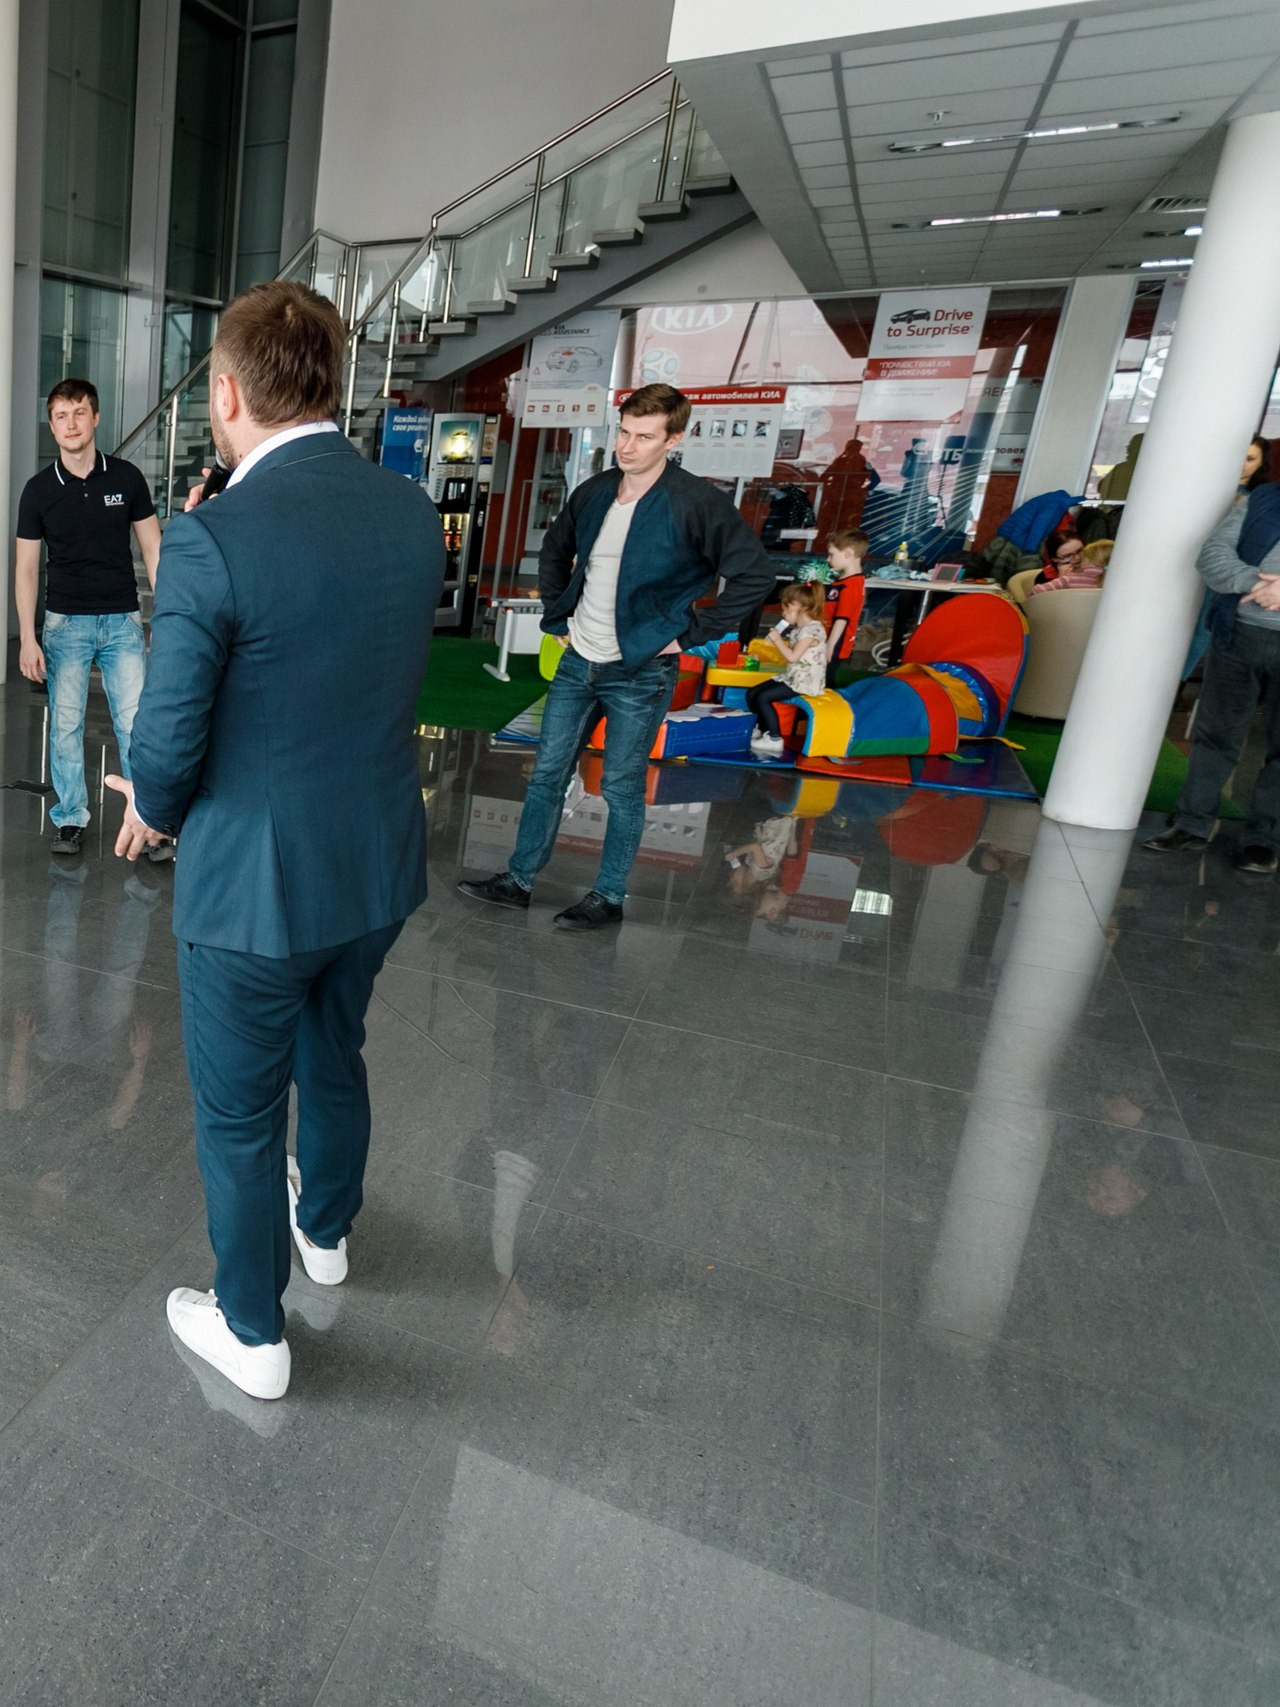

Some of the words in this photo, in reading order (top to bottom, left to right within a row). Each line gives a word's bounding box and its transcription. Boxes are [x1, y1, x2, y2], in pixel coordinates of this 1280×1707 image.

[933, 308, 973, 322] Drive
[886, 326, 902, 338] to
[701, 390, 759, 400] автомобилей
[760, 390, 781, 399] КИА
[103, 493, 123, 504] EA7
